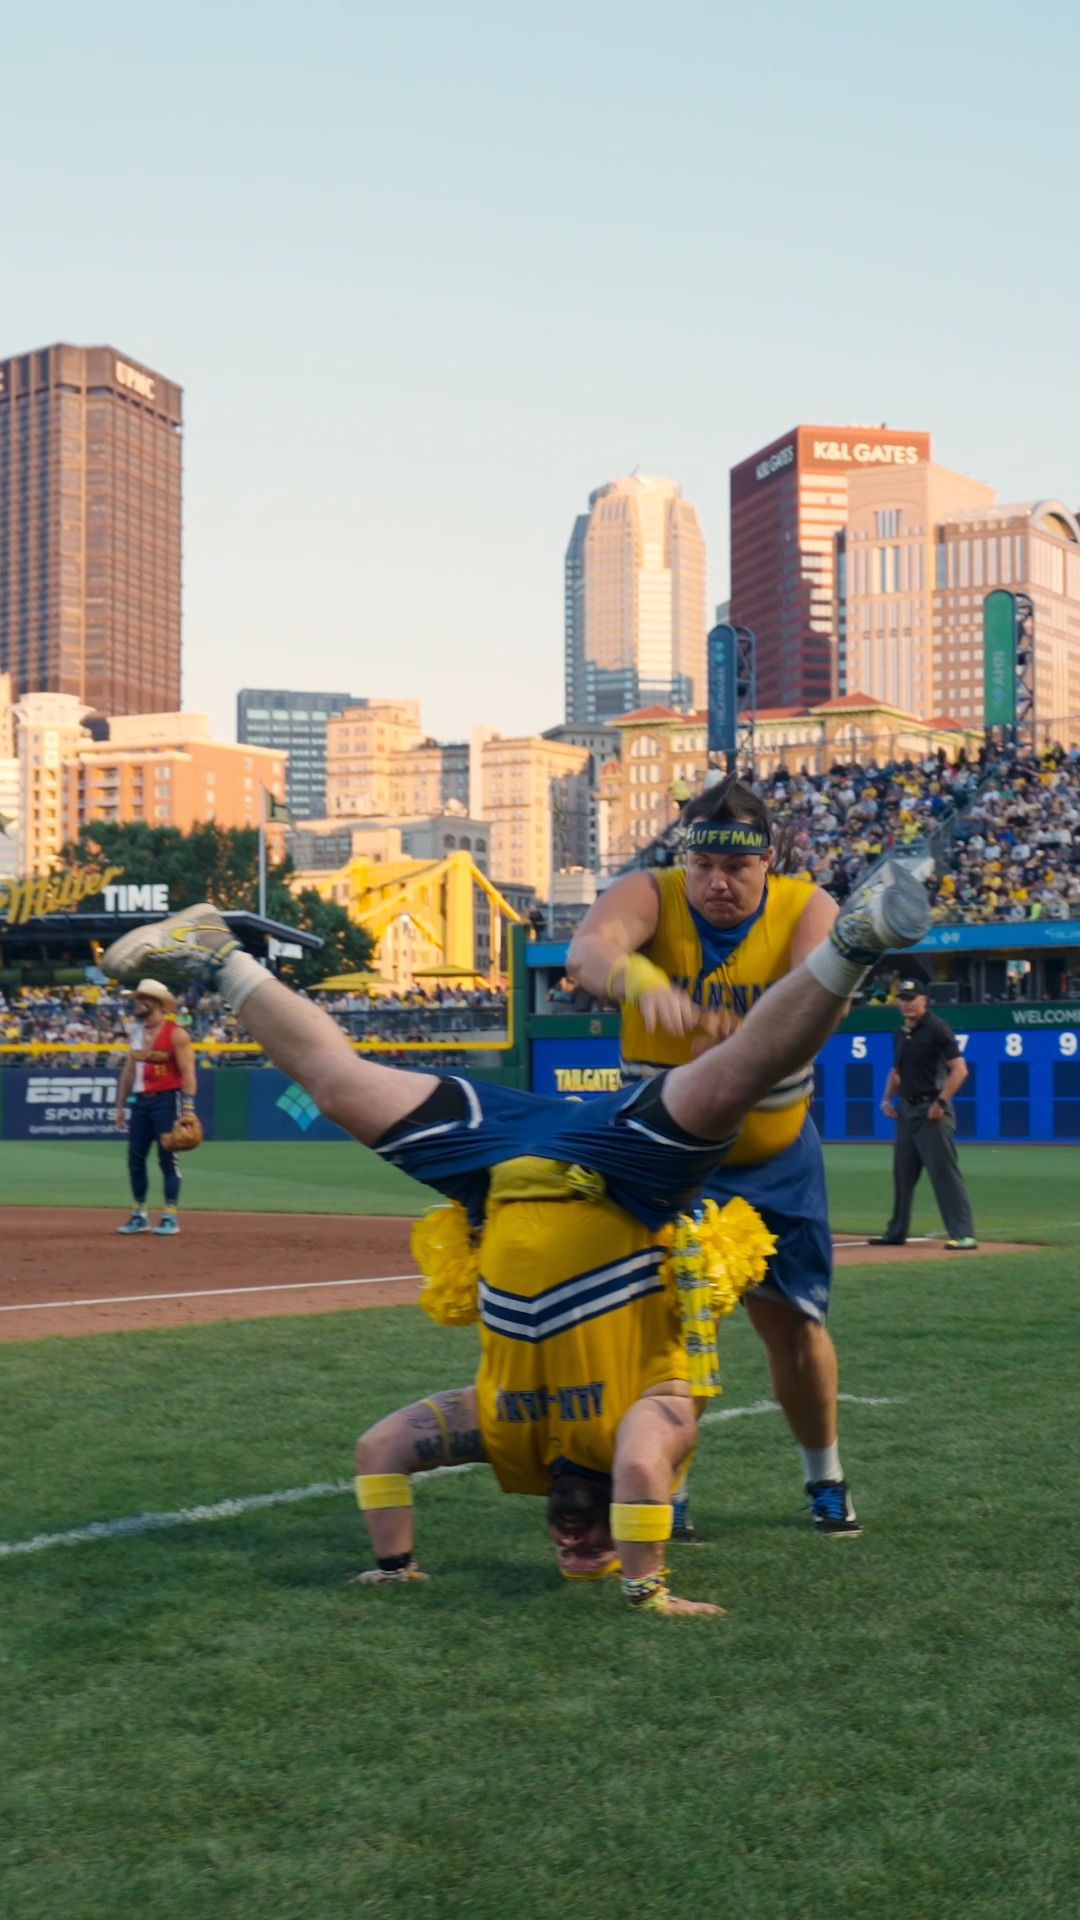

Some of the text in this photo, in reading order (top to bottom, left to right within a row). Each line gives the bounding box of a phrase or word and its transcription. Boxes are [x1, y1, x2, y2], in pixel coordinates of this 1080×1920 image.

[813, 441, 918, 464] K&L GATES
[0, 866, 169, 924] Miller TIME
[851, 1032, 1078, 1059] 5 7 8 9
[26, 1077, 117, 1103] ESPN
